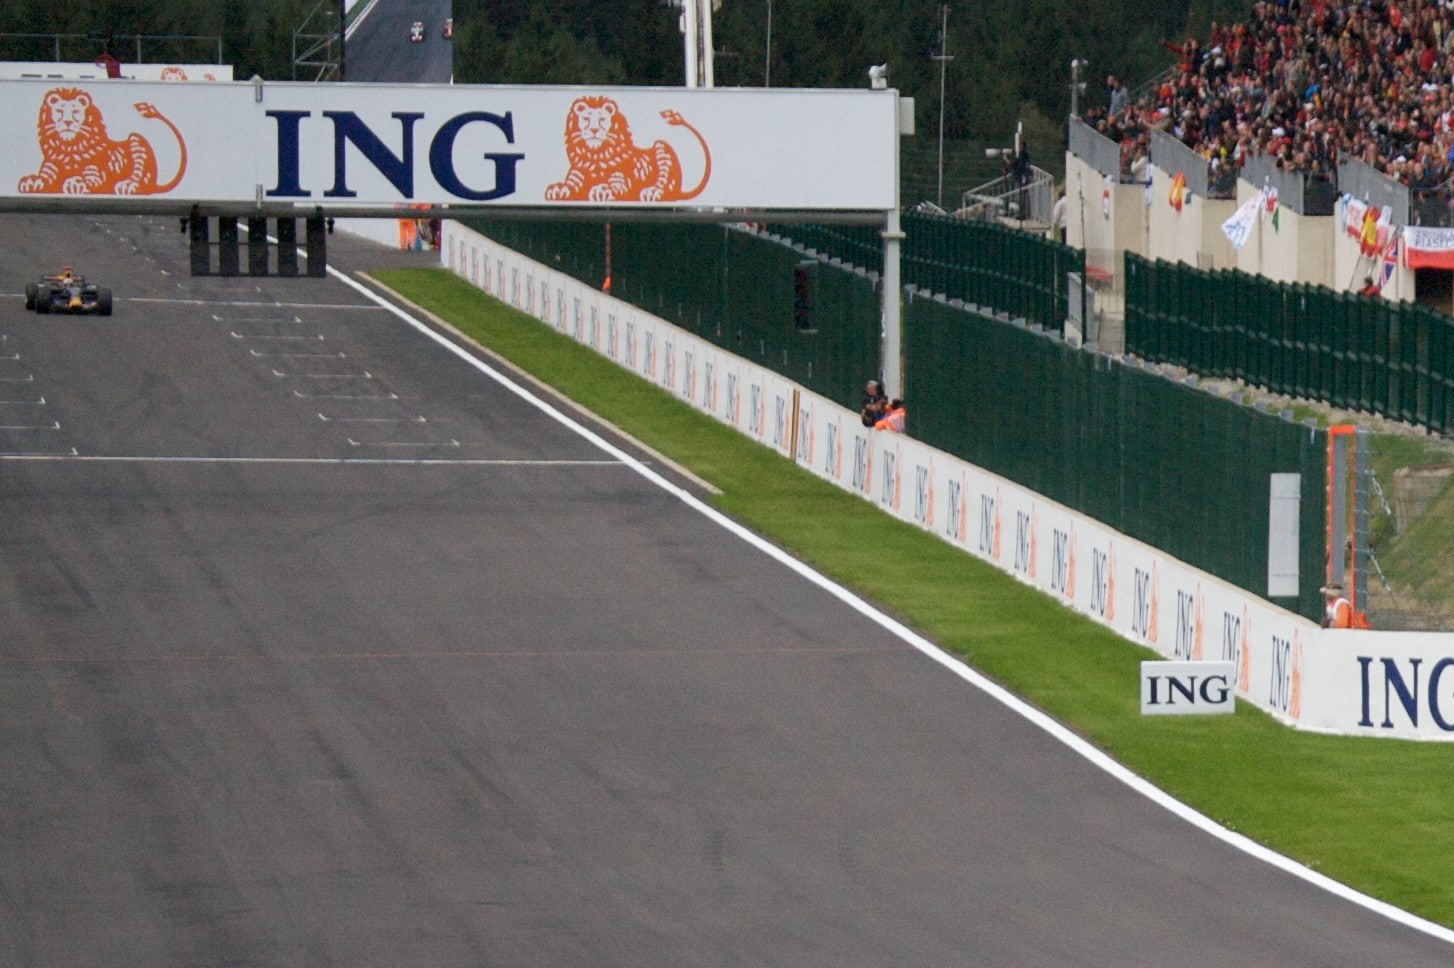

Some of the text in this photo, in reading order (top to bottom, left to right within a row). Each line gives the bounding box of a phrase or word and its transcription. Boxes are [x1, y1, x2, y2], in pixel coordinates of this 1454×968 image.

[265, 110, 525, 201] ING
[1090, 548, 1106, 617] ING
[1132, 568, 1149, 638] ING
[1175, 590, 1193, 661] ING
[1147, 675, 1230, 705] ING
[1270, 635, 1290, 712] ING
